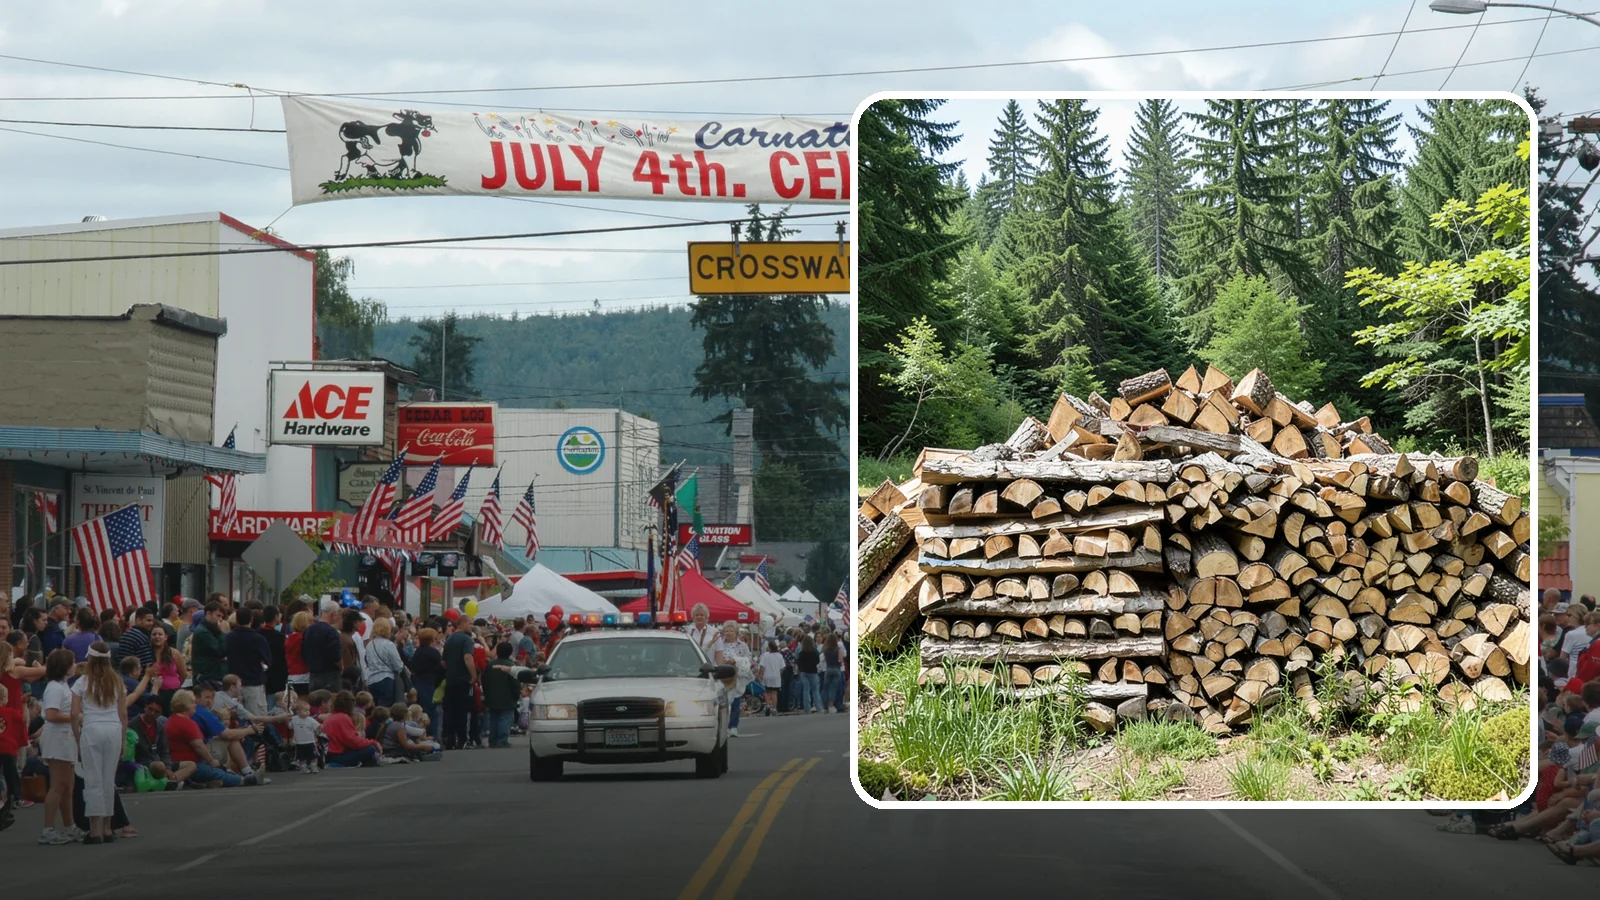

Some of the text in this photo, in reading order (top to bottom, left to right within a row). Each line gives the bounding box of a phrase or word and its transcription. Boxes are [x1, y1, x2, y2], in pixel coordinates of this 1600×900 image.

[481, 141, 605, 192] JULY
[632, 150, 747, 198] 4th.
[697, 254, 850, 280] CROSSWA
[283, 380, 373, 420] ACE
[406, 409, 452, 422] CEDAR
[283, 421, 371, 437] Hardware
[353, 467, 385, 481] Simpl
[83, 485, 155, 496] St. Vincent de Paul
[688, 526, 741, 535] CRNATION
[699, 535, 730, 543] GLASS
